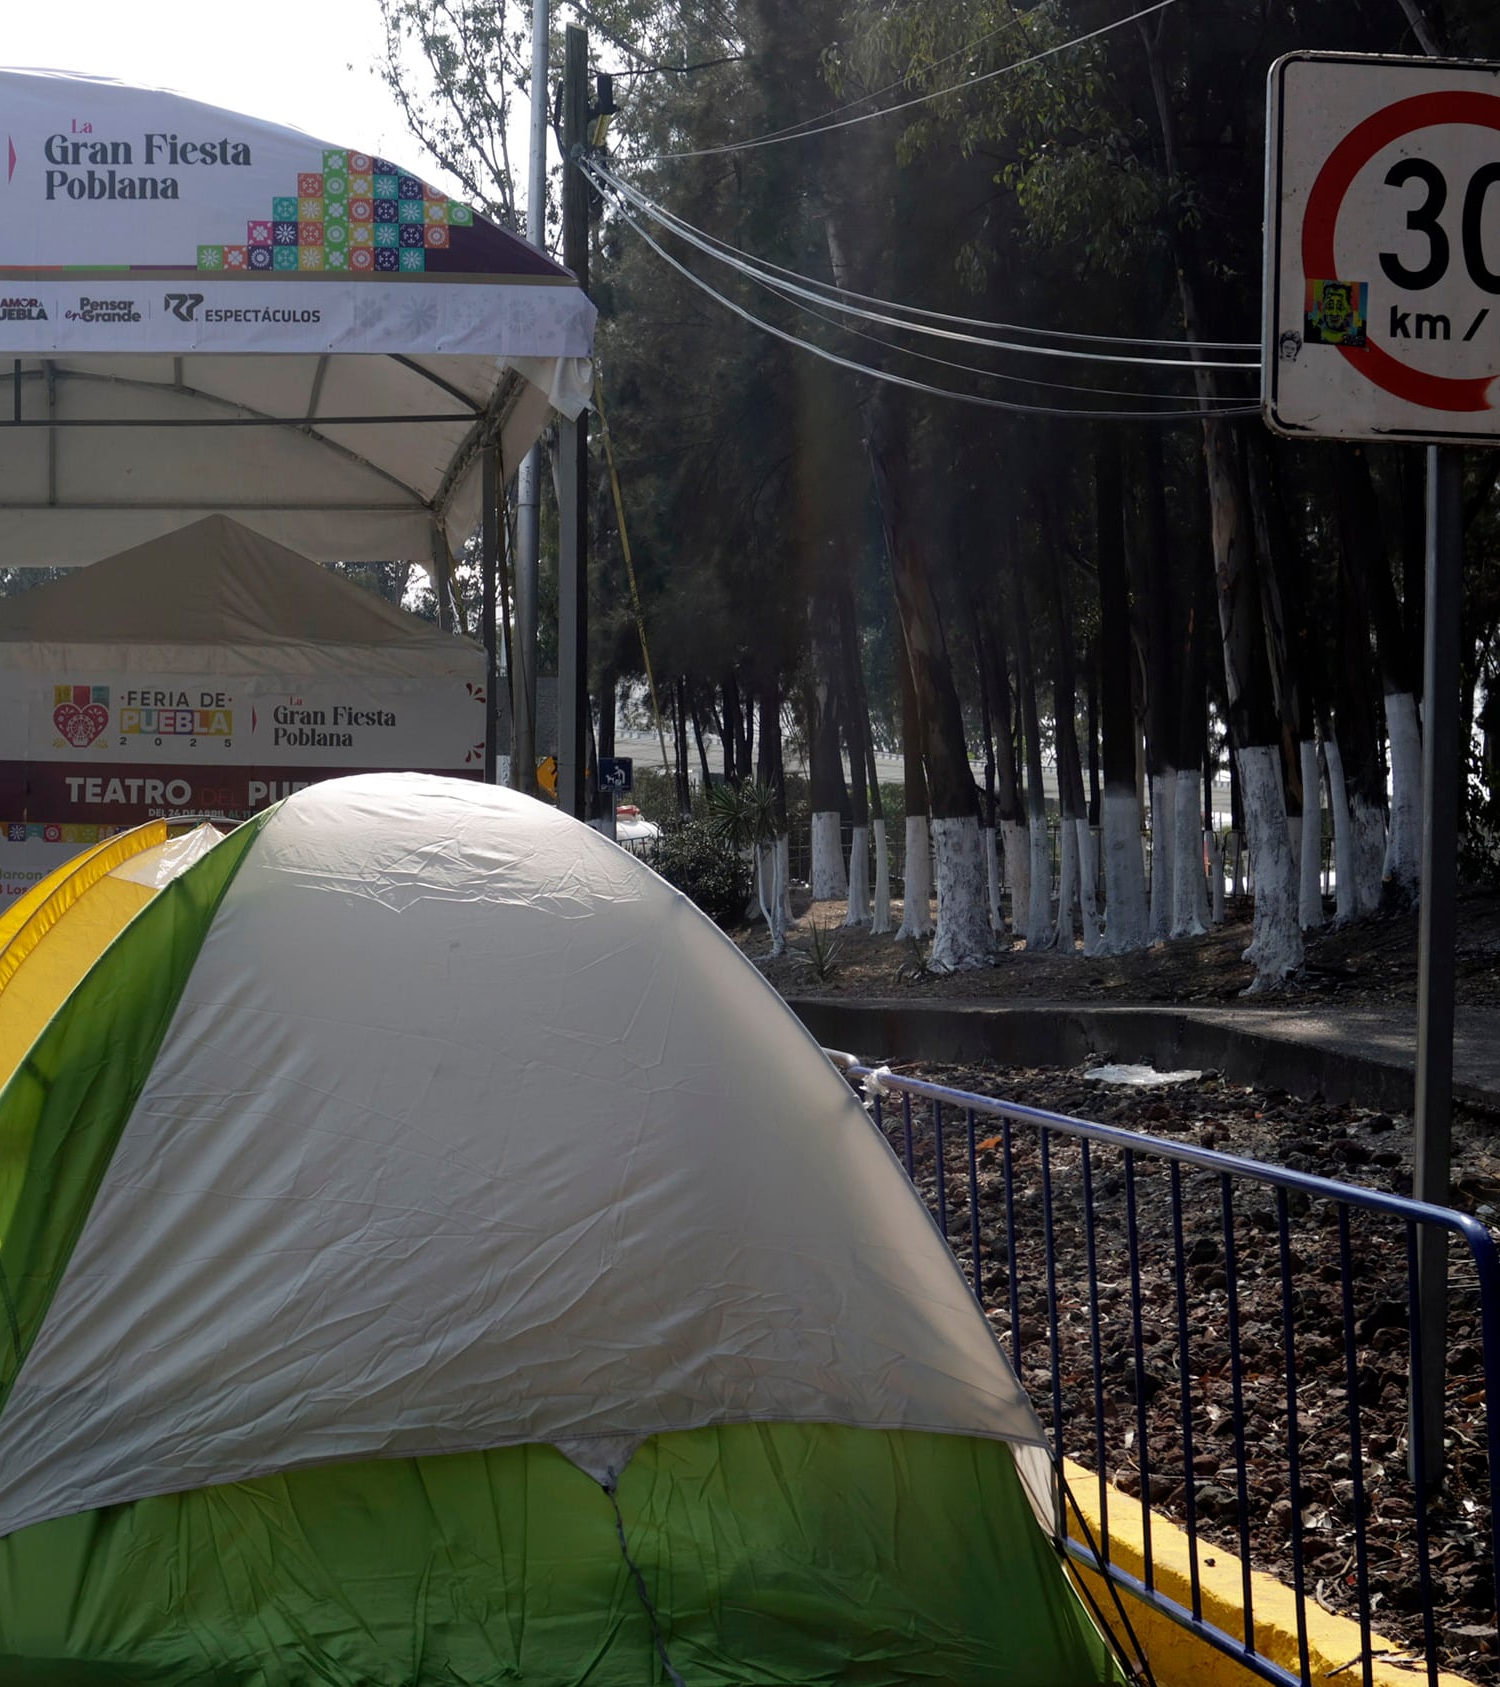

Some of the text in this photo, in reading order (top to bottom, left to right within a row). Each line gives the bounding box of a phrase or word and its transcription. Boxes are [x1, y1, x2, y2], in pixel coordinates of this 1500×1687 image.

[71, 118, 93, 134] La
[44, 133, 252, 166] Gran Fiesta
[45, 170, 180, 200] Poblana
[79, 297, 135, 311] Pensar
[81, 310, 142, 322] Grande
[205, 307, 321, 322] ESPECTÁCULOS
[127, 691, 226, 708] FERIA DE
[121, 709, 231, 735] PUEBLA
[273, 705, 396, 727] Gran Fiesta
[274, 727, 353, 747] Poblana
[65, 777, 192, 806] TEATRO
[200, 787, 241, 806] DEL
[148, 808, 165, 817] DEL
[169, 808, 180, 817] 24
[182, 808, 196, 817] DE
